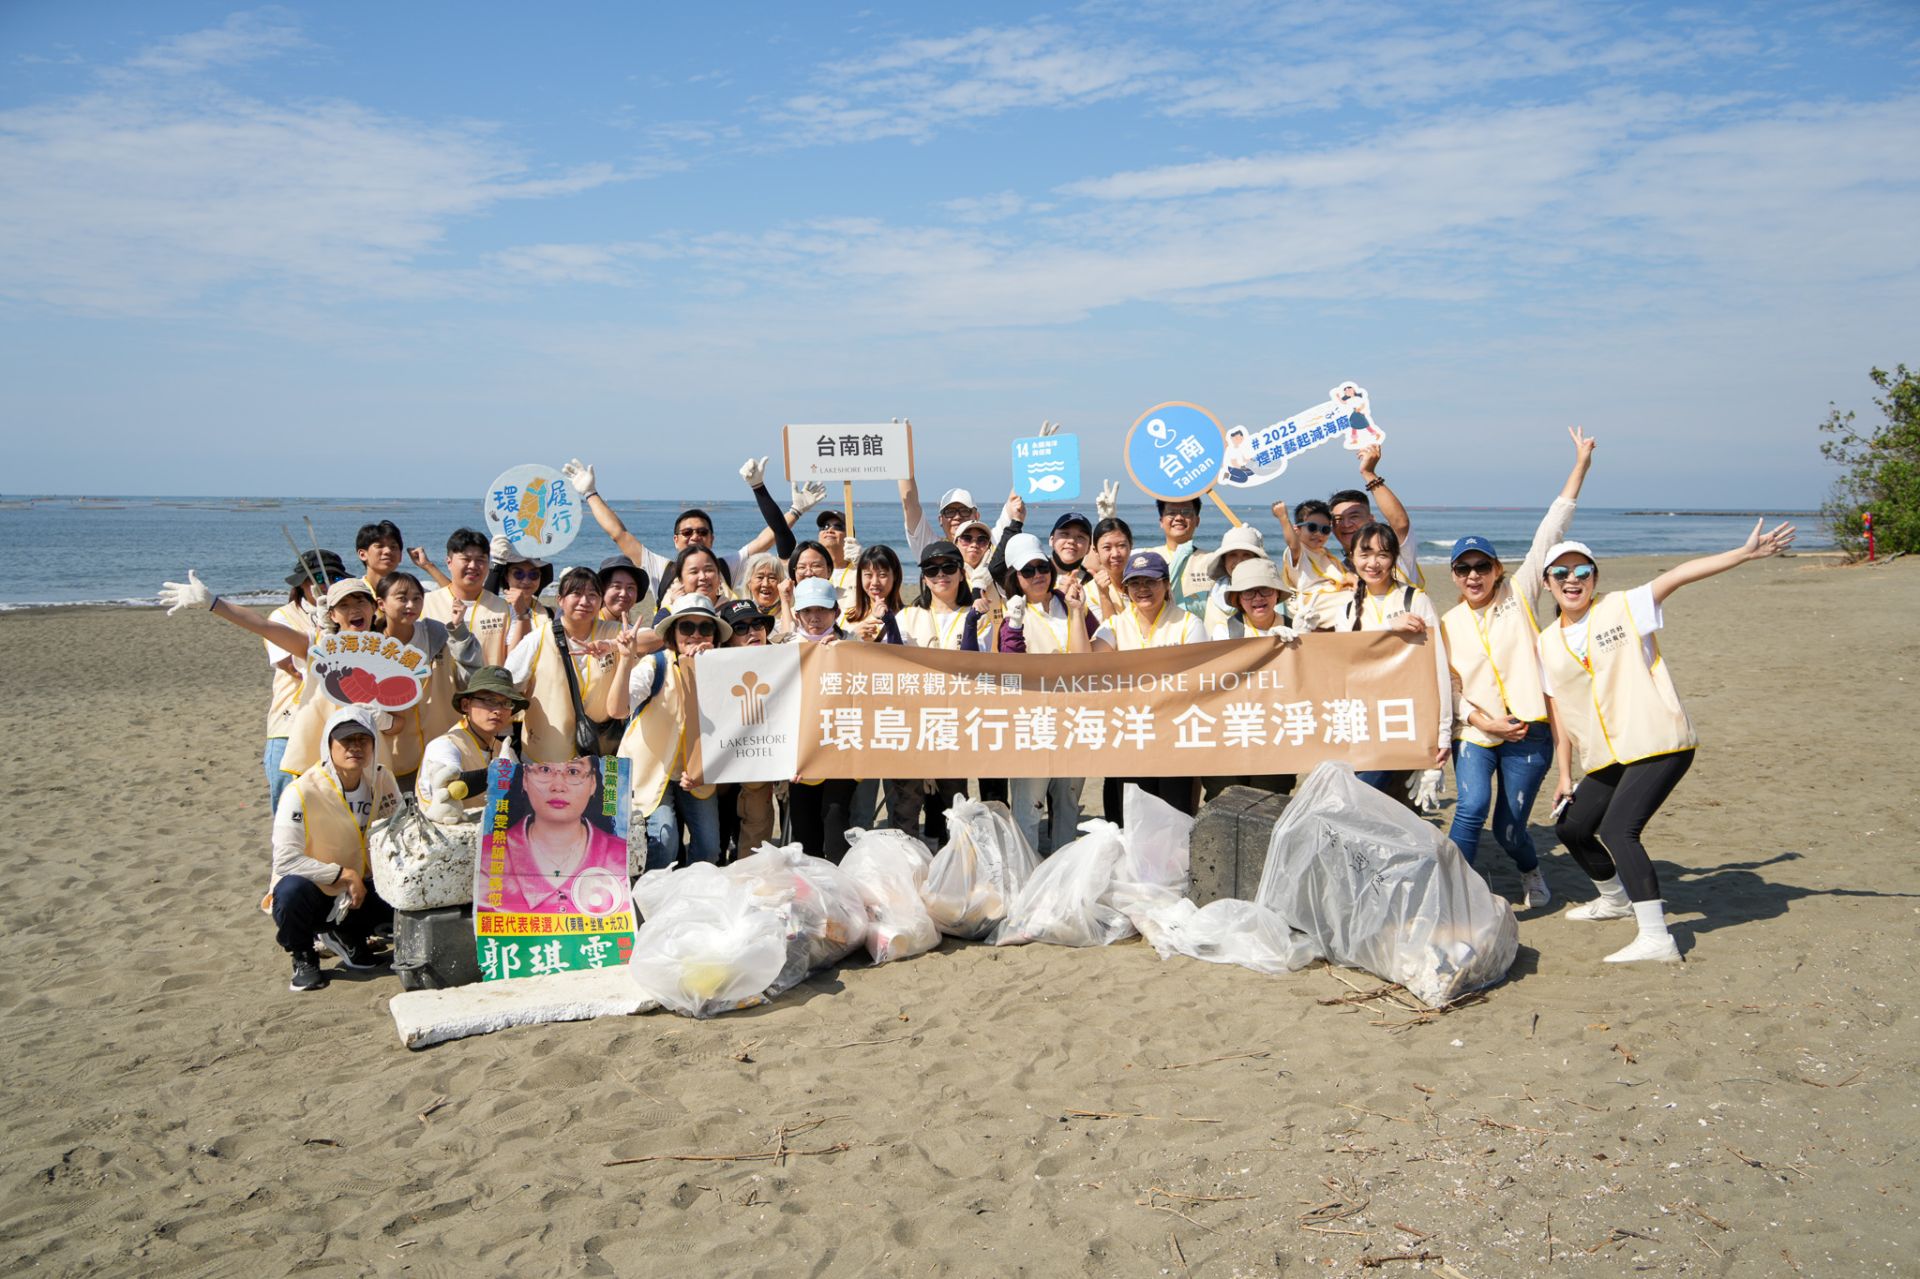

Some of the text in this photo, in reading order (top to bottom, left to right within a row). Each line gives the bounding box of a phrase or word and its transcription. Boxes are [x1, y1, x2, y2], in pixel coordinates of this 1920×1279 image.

[816, 434, 884, 457] 台南館
[1255, 414, 1350, 468] 煙波藝起減海廢
[1261, 421, 1297, 445] 2025
[1016, 442, 1029, 458] 14
[1158, 434, 1205, 479] 台南
[820, 466, 861, 475] LAKESHORE
[1173, 457, 1215, 490] Tainan
[493, 485, 526, 544] 環島
[547, 480, 573, 534] 履行
[819, 672, 1023, 696] 煙波國際觀光集團
[1040, 669, 1285, 695] LAKESHORE HOTEL
[819, 698, 1418, 752] 環島履行護海洋 企業淨灘日
[720, 734, 788, 749] LAKESHORE
[735, 748, 775, 759] HOTEL
[479, 935, 613, 980] 郭琪雯
